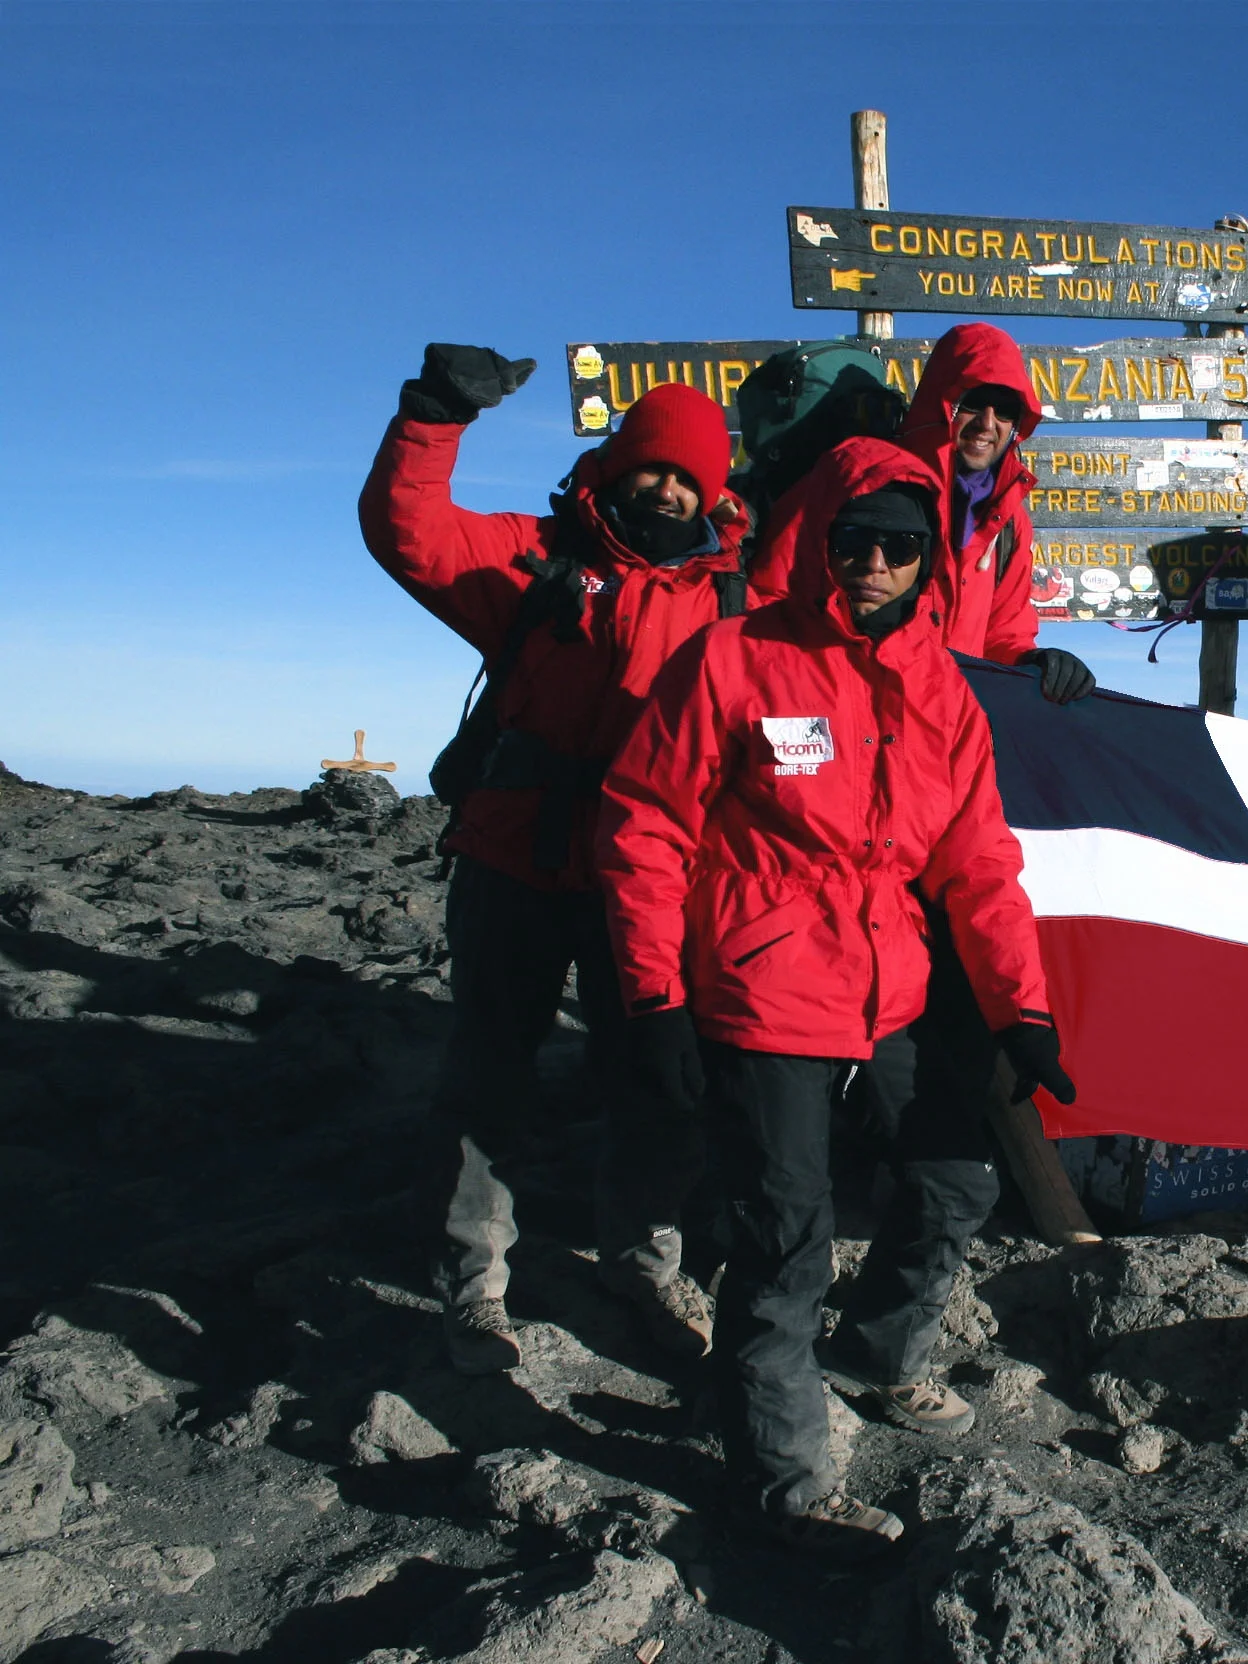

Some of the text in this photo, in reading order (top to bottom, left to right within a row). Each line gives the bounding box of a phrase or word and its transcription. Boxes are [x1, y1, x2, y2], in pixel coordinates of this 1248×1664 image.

[917, 270, 1161, 304] YOU ARE NOW AT
[606, 360, 763, 411] UHUR
[1030, 357, 1208, 404] NZANIA,
[1051, 451, 1132, 477] POINT
[1029, 488, 1247, 513] FREE-STANDING
[1032, 542, 1136, 567] ARGEST
[773, 741, 824, 756] ricom
[774, 764, 819, 776] GORE-TEX
[1153, 1161, 1235, 1190] SWISS
[1190, 1182, 1236, 1199] SOLID
